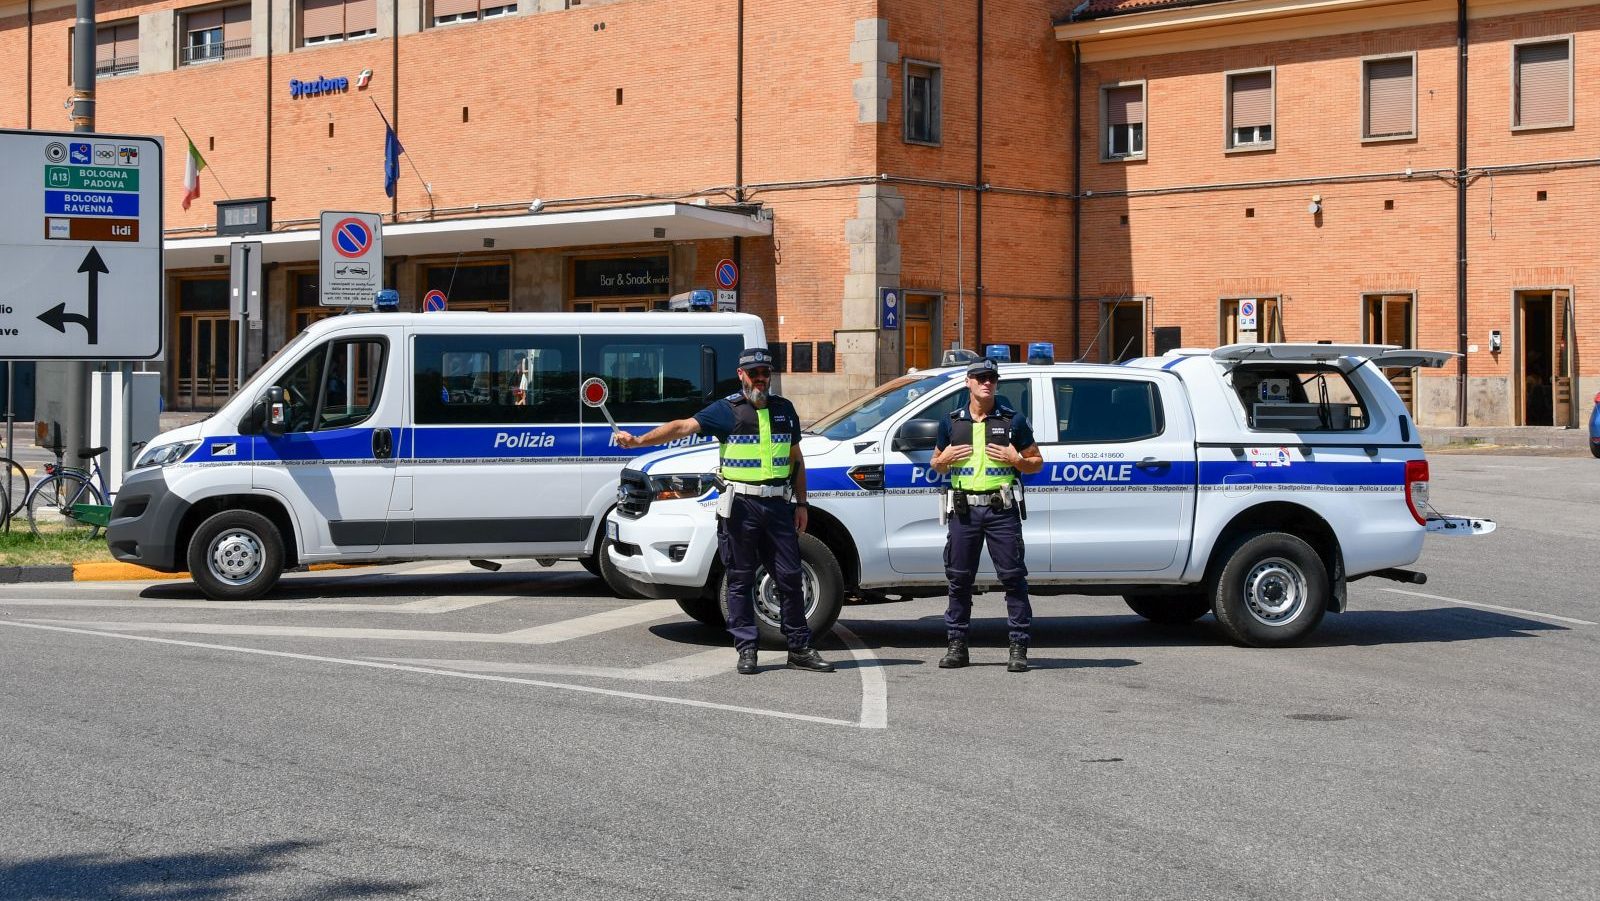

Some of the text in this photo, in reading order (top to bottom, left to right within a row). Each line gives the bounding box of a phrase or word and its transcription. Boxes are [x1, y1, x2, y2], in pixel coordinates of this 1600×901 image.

[290, 76, 348, 96] Stazione
[52, 172, 68, 182] A13
[79, 169, 128, 179] BOLOGNA
[83, 179, 125, 188] PADOVA
[64, 194, 113, 203] BOLOGNA
[64, 204, 113, 213] RAVENNA
[111, 225, 131, 236] lidi
[600, 274, 615, 286] Bar
[617, 273, 624, 286] &
[625, 270, 651, 285] Snack
[0, 304, 13, 314] io
[494, 432, 555, 448] Polizia
[1051, 464, 1133, 482] LOCALE
[1152, 485, 1188, 493] Stadtpolizei
